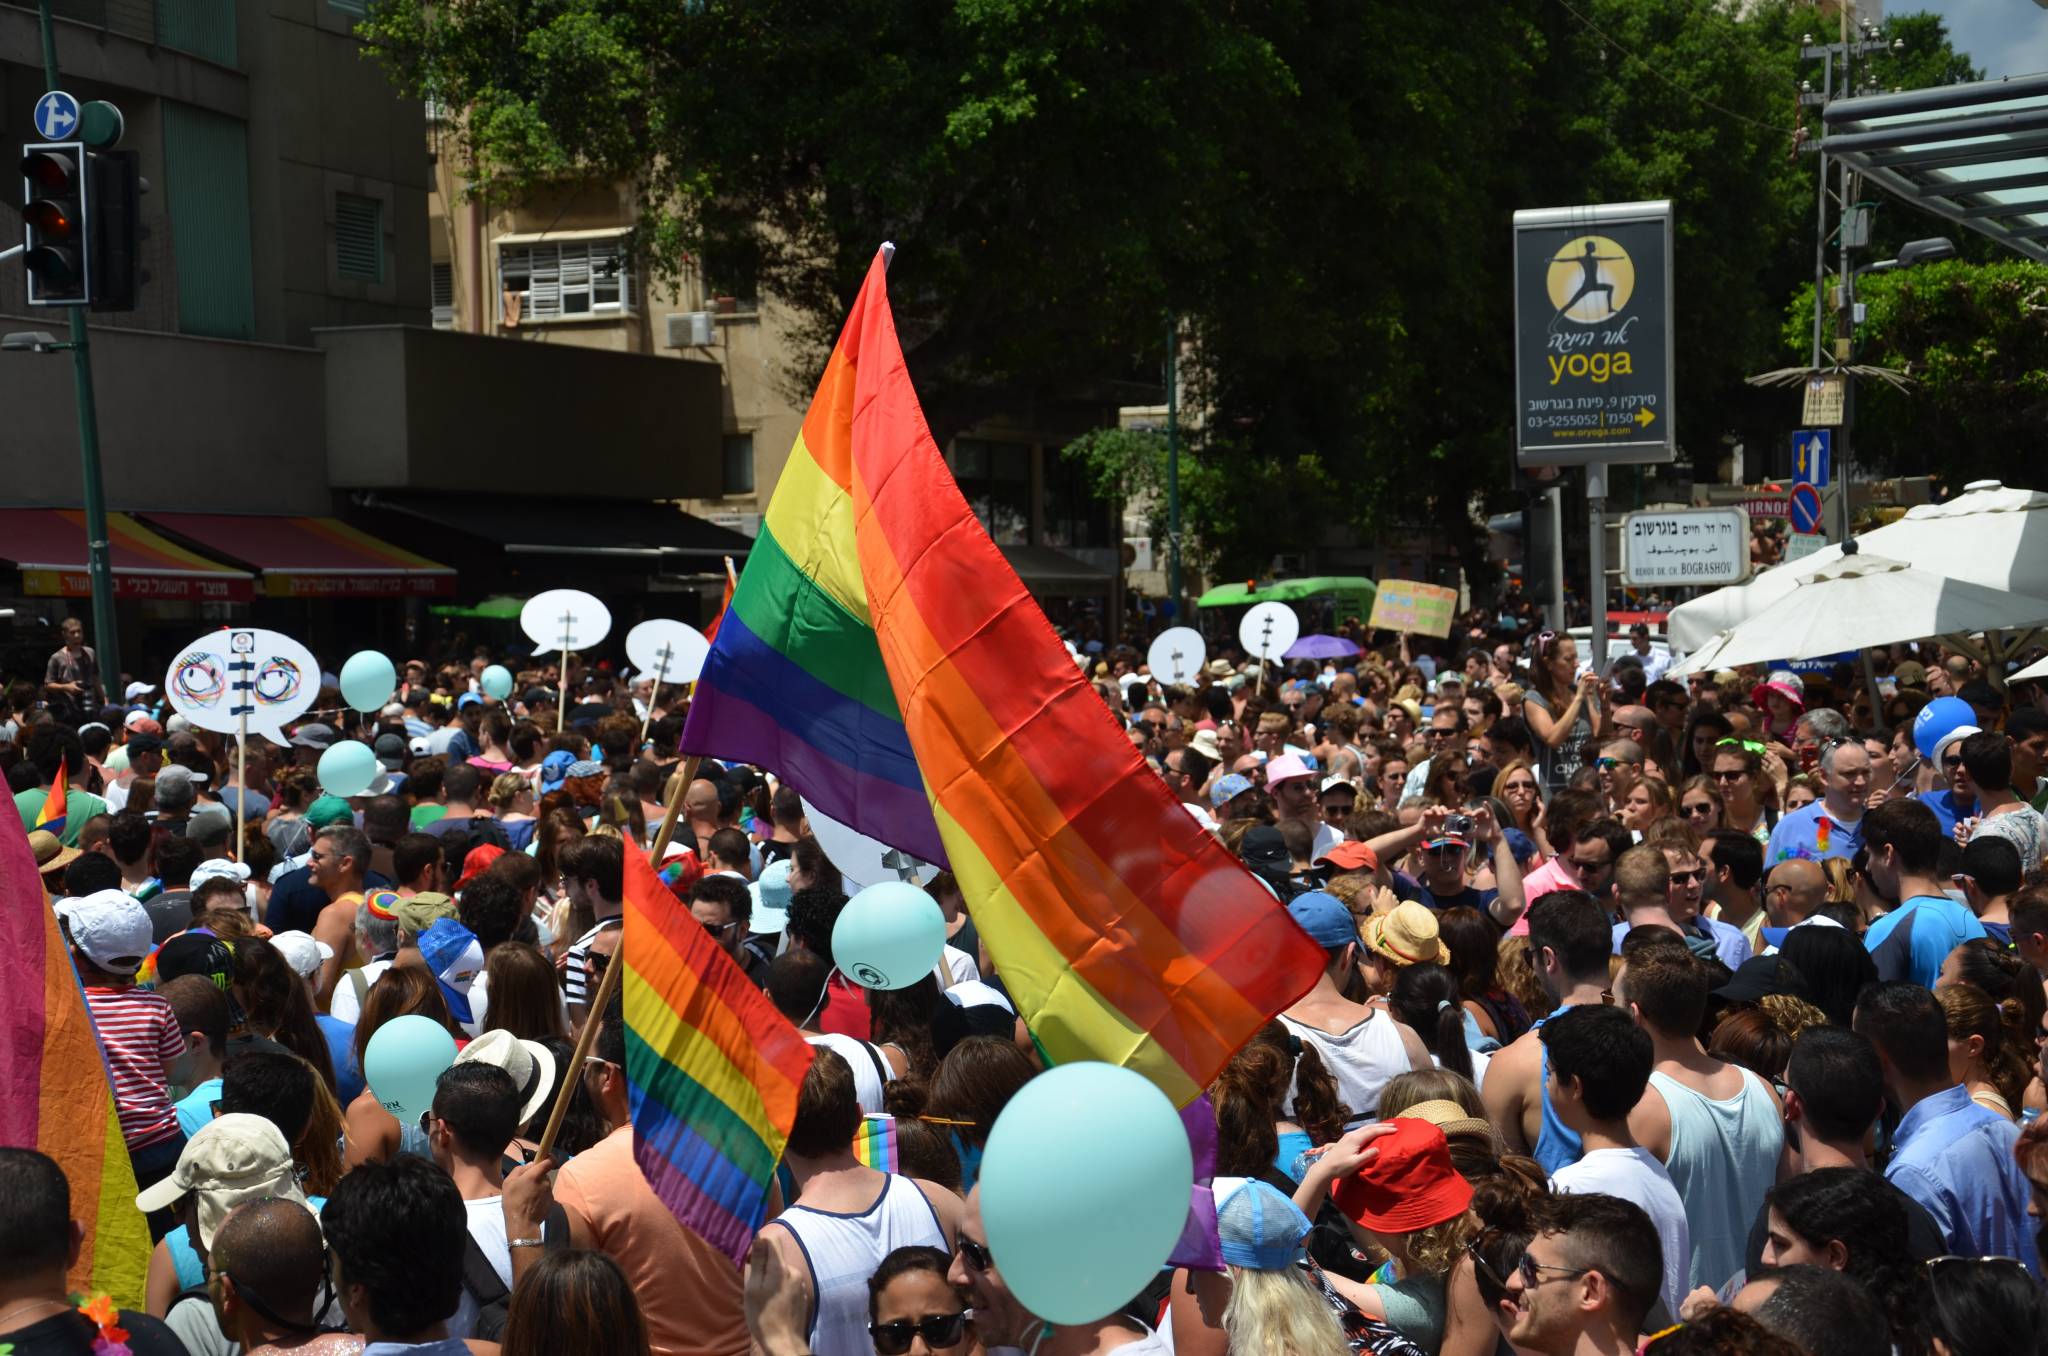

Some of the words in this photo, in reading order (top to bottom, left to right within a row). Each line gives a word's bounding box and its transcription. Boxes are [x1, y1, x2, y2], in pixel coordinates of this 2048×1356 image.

[1601, 316, 1639, 345] אור
[1547, 331, 1595, 353] היוגה
[1547, 351, 1633, 386] yoga
[1528, 398, 1574, 411] בוגרשוב
[1577, 397, 1604, 409] פינת
[1621, 394, 1657, 409] סירקין
[1527, 414, 1598, 428] 03-5255052
[1553, 427, 1631, 438] www.oryoga.com
[1734, 501, 1790, 514] MIRNOF
[1635, 521, 1678, 536] בוגרשוב
[1682, 525, 1700, 535] חיים
[1635, 567, 1654, 576] REHOV
[1681, 561, 1732, 575] BOGRASHOV
[196, 580, 229, 596] מוצרי
